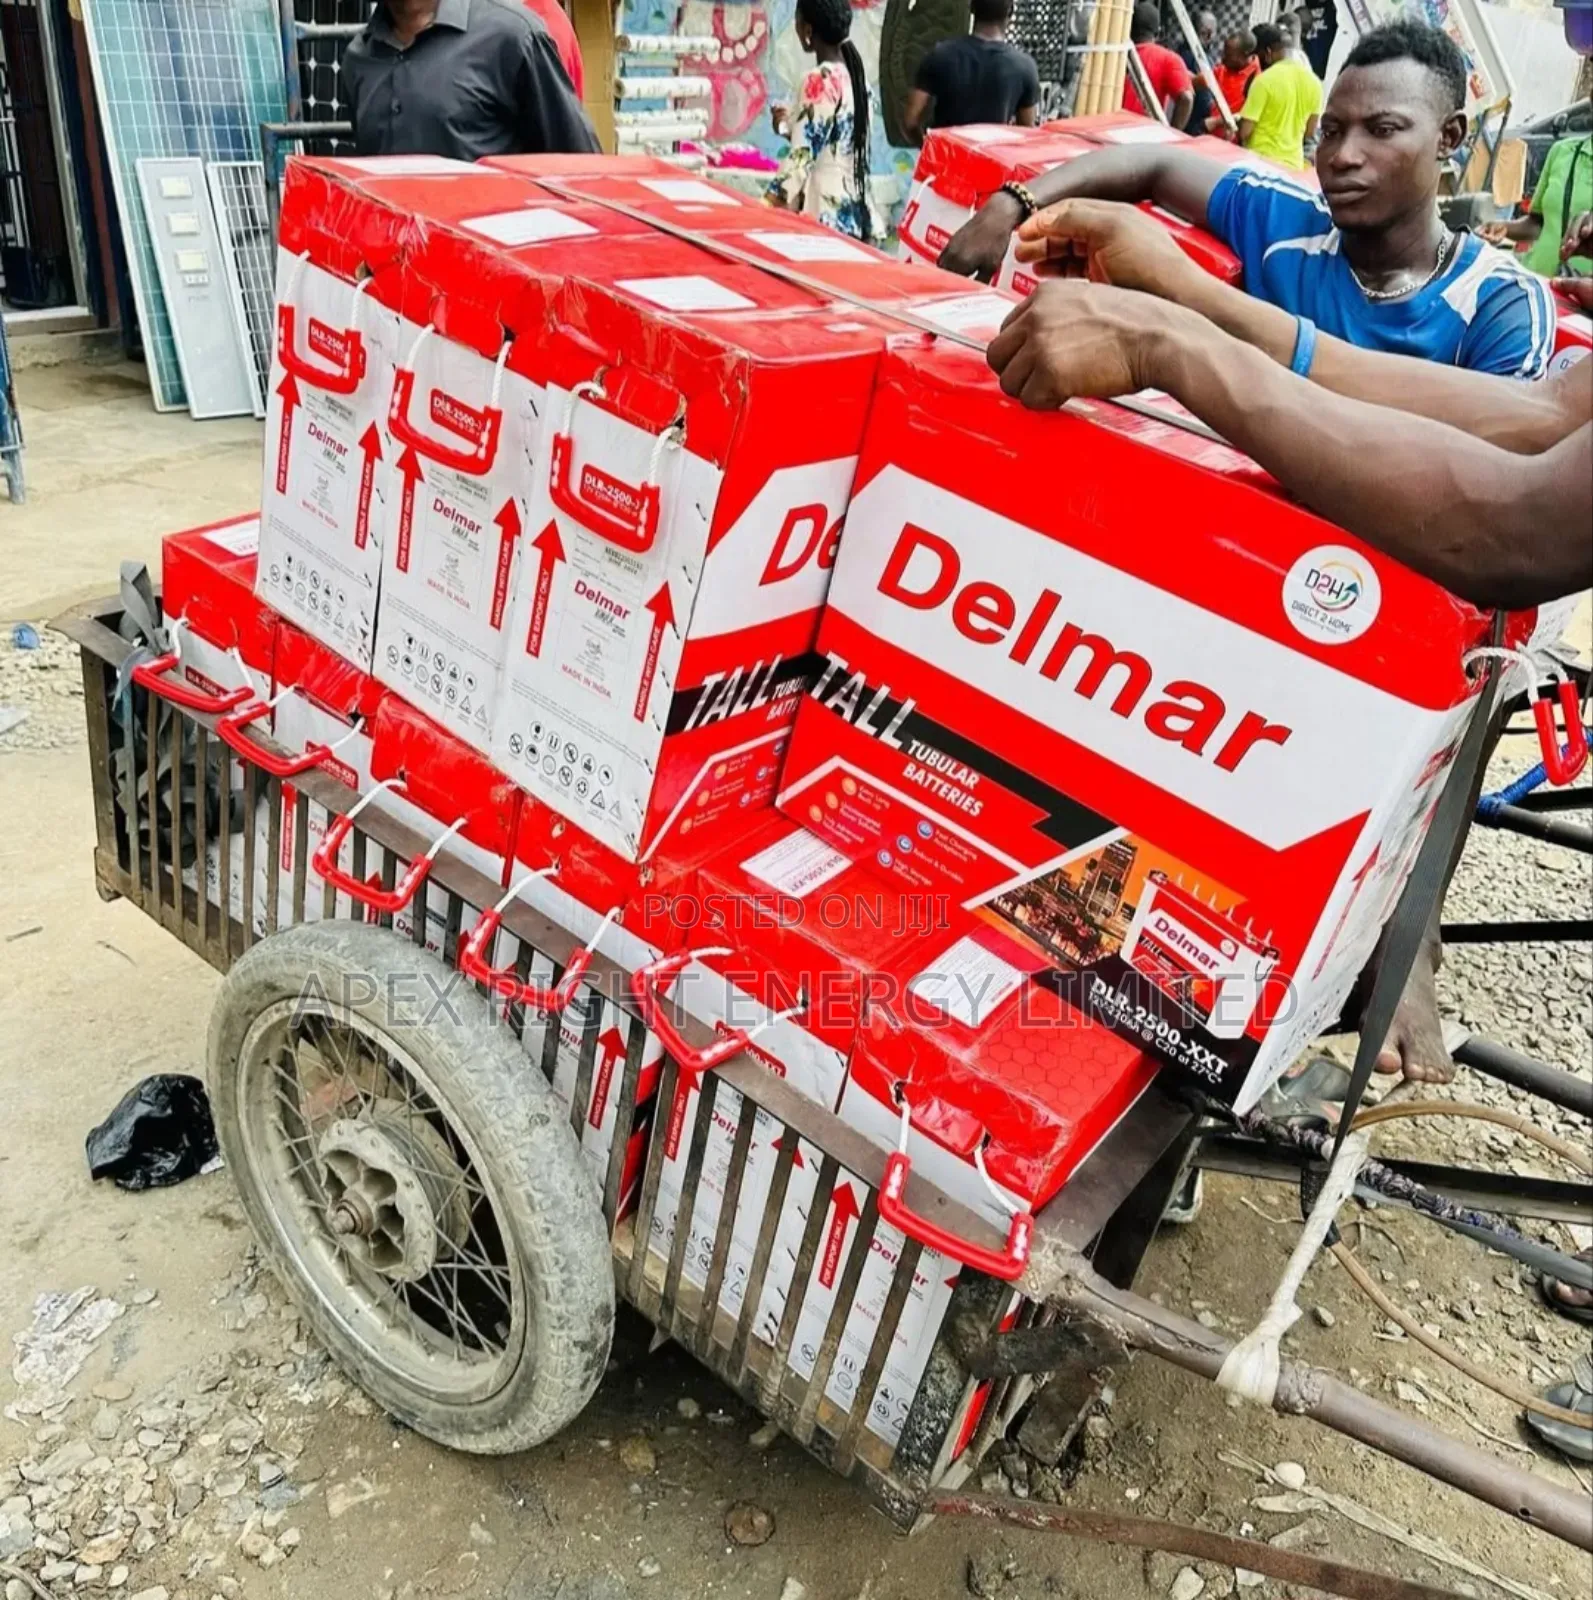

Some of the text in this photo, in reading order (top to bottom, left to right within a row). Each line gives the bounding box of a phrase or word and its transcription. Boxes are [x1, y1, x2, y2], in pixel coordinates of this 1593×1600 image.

[307, 422, 348, 456] Delmar
[433, 497, 483, 534] Delmar
[529, 568, 550, 652] FOR EXPORT ONLY
[575, 579, 631, 619] Delmar
[1304, 568, 1345, 599] D2H
[1291, 600, 1320, 618] DIRECT
[1319, 612, 1329, 623] 2
[1328, 617, 1353, 633] HOME
[634, 626, 661, 716] HANDLE WITH CARE
[877, 522, 1292, 772] Delmar
[683, 653, 783, 732] TALL
[811, 652, 979, 790] TALL TUBULAR
[903, 764, 984, 817] BATTERIES
[1154, 917, 1221, 971] Delmar
[1091, 977, 1229, 1075] DLR-2500-XXT
[1141, 1028, 1154, 1041] @
[1155, 1037, 1177, 1056] C20
[1178, 1054, 1190, 1065] at
[821, 1267, 831, 1283] FOR
[832, 1218, 844, 1239] ONLY
